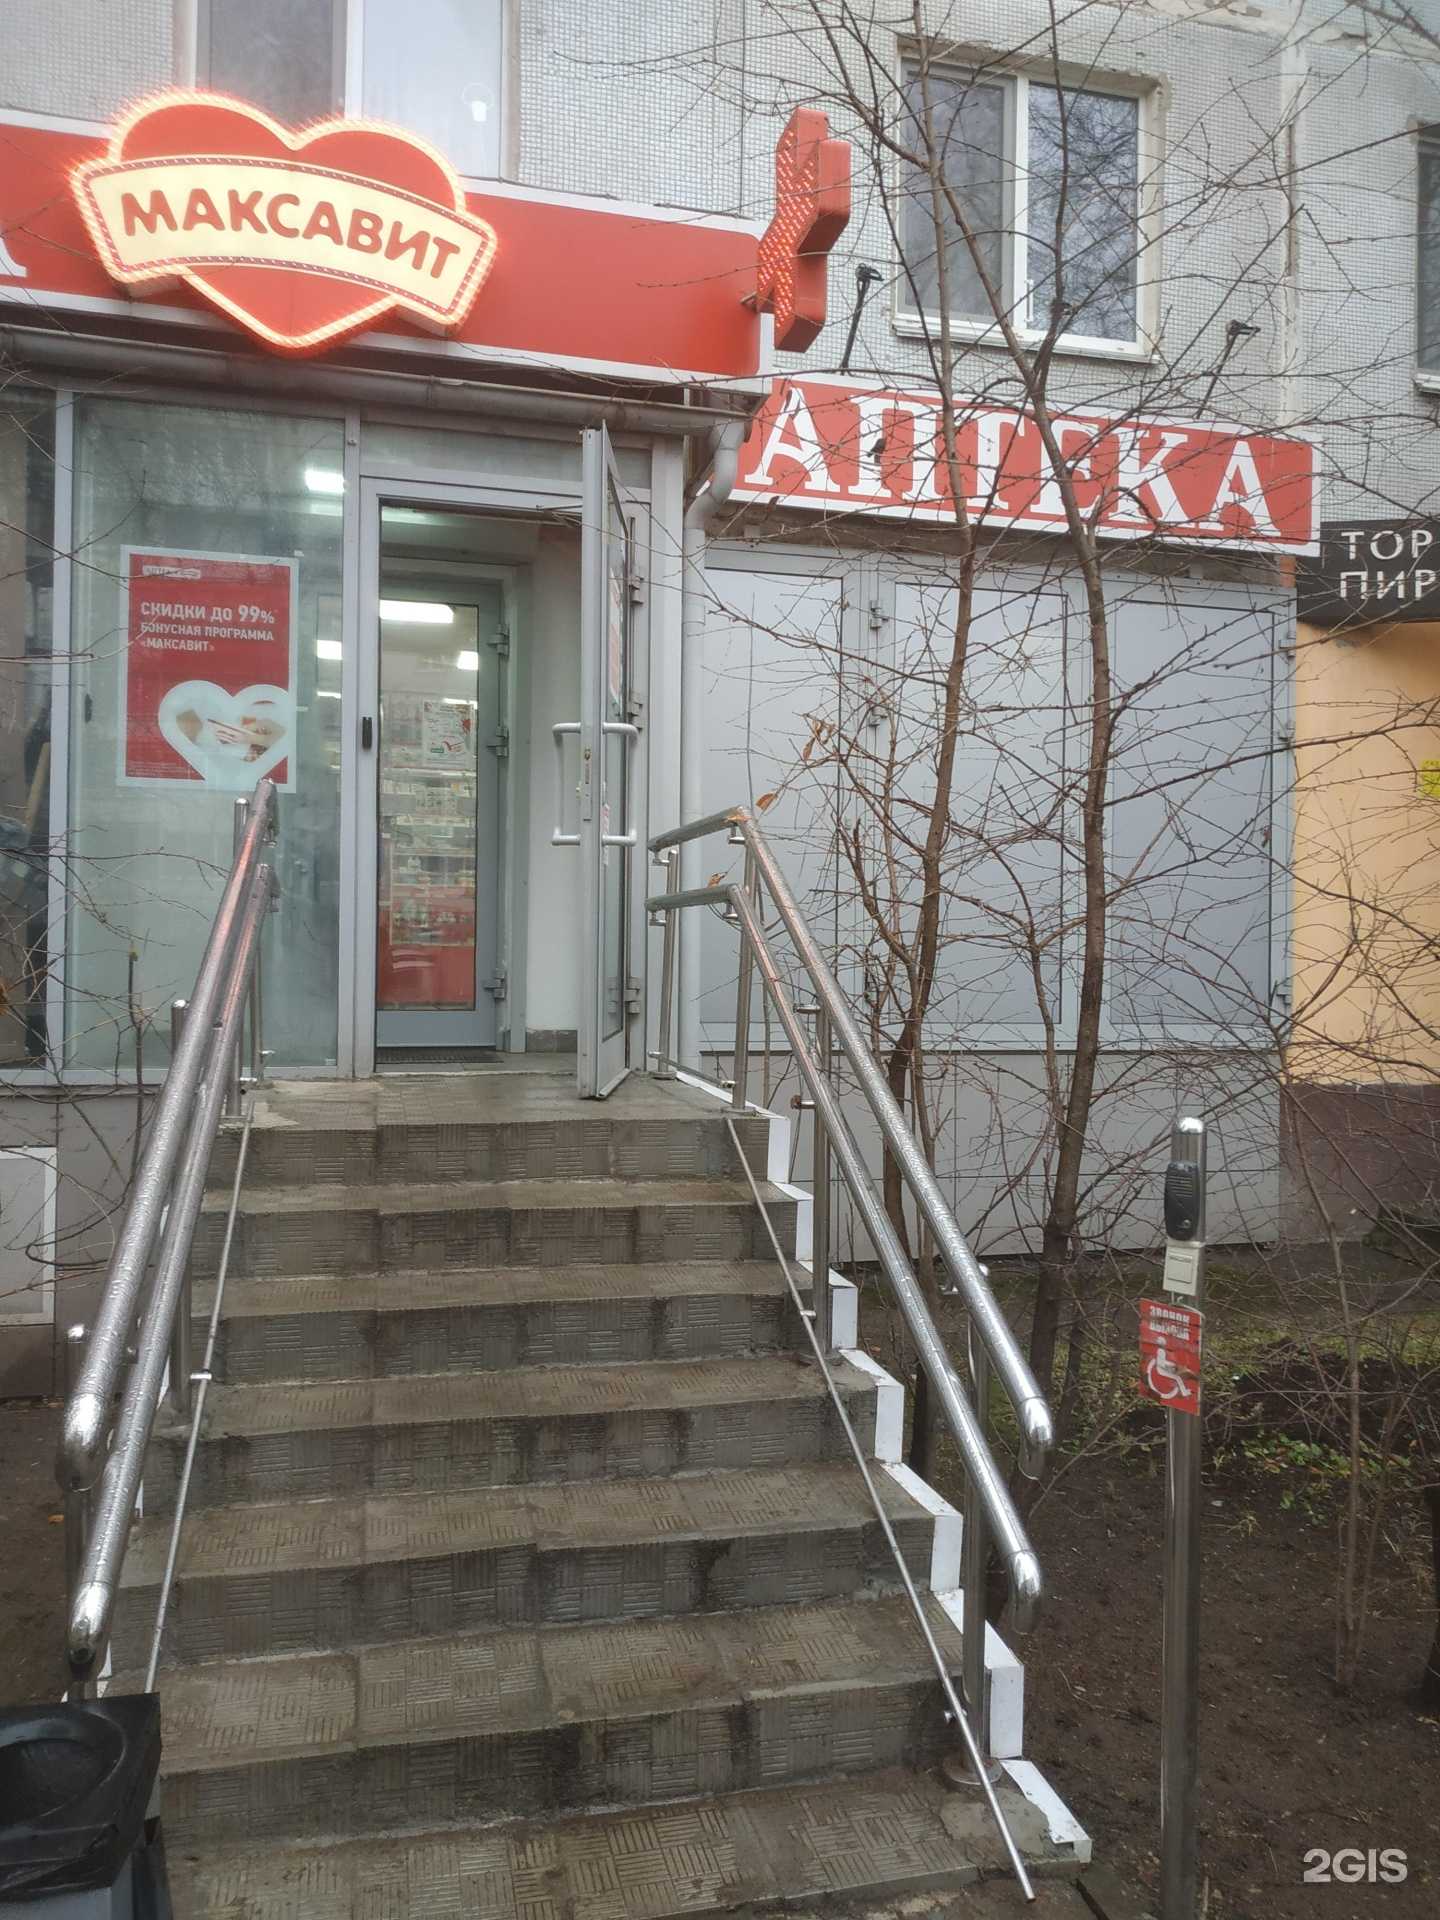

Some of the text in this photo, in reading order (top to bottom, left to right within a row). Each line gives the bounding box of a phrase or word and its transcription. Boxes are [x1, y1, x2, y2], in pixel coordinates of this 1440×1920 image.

[121, 188, 460, 279] МАКСАВИТ
[743, 386, 1283, 537] АПТЕКА
[1341, 529, 1433, 560] ТОР
[1340, 569, 1437, 600] ПИР
[140, 601, 206, 620] СКИДКИ
[211, 607, 233, 623] ДО
[140, 622, 274, 641] БОНУСНАЯ ПРОГРАММА
